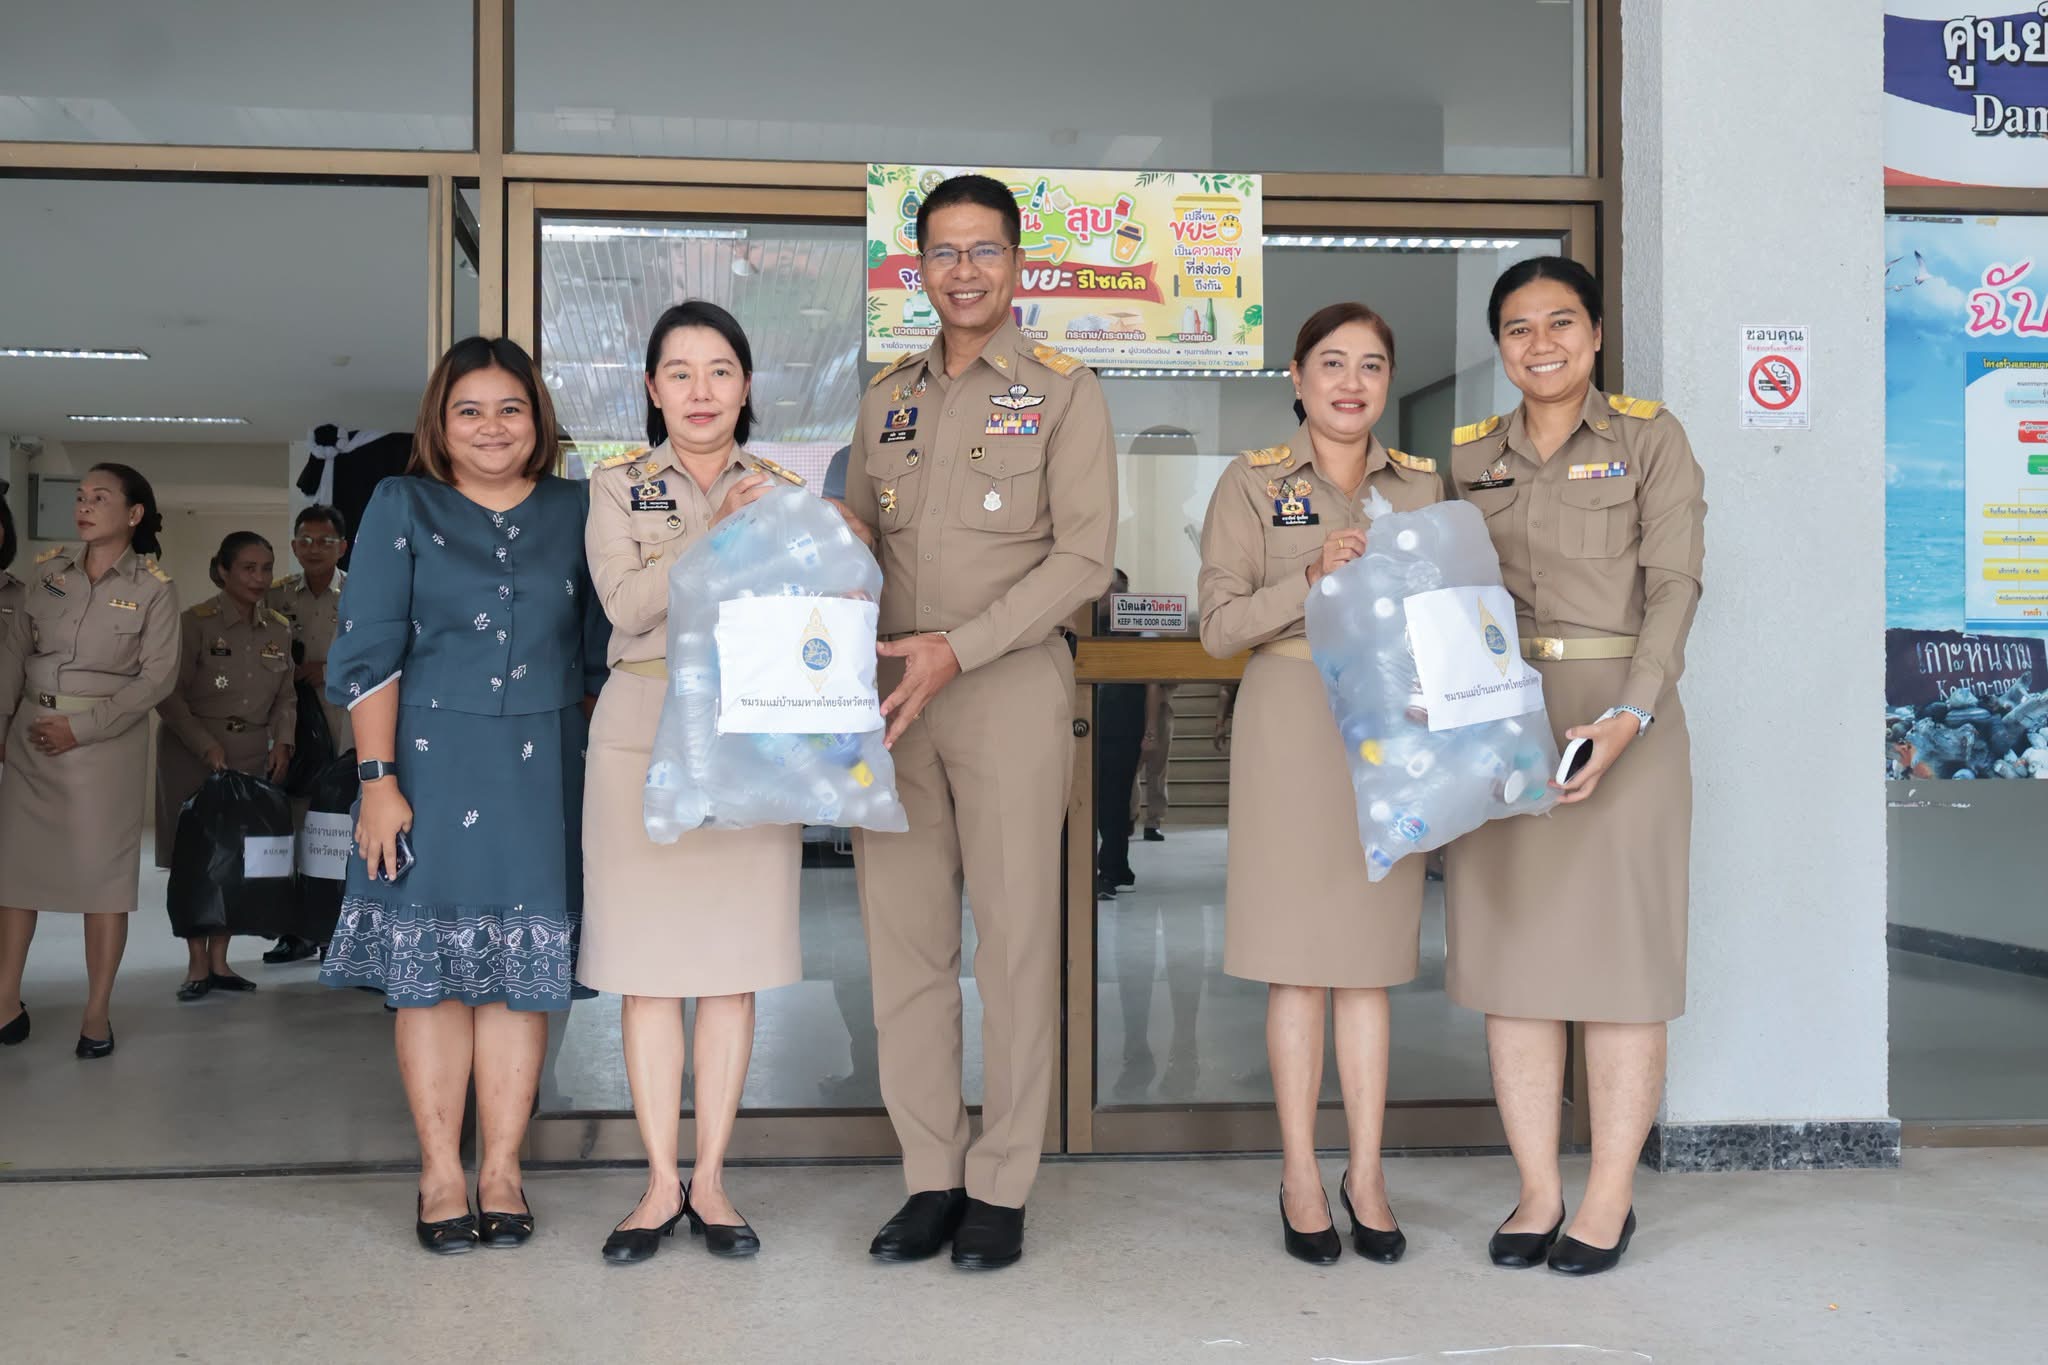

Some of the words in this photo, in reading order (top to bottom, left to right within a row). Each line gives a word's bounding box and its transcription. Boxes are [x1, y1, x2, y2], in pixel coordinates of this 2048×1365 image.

[1184, 208, 1216, 221] เปลี่ยน
[1067, 207, 1112, 241] สุข
[1169, 221, 1217, 241] ขยะ
[1185, 257, 1231, 275] ที่ส่งต่อ
[1076, 268, 1147, 291] รีไซเคิล
[1195, 279, 1221, 290] ถึงกัน
[1746, 329, 1804, 345] ขอบคุณ
[1117, 617, 1131, 626] KEEP
[1133, 617, 1143, 626] THE
[1144, 617, 1160, 626] DOOR
[1161, 617, 1182, 626] CLOSED
